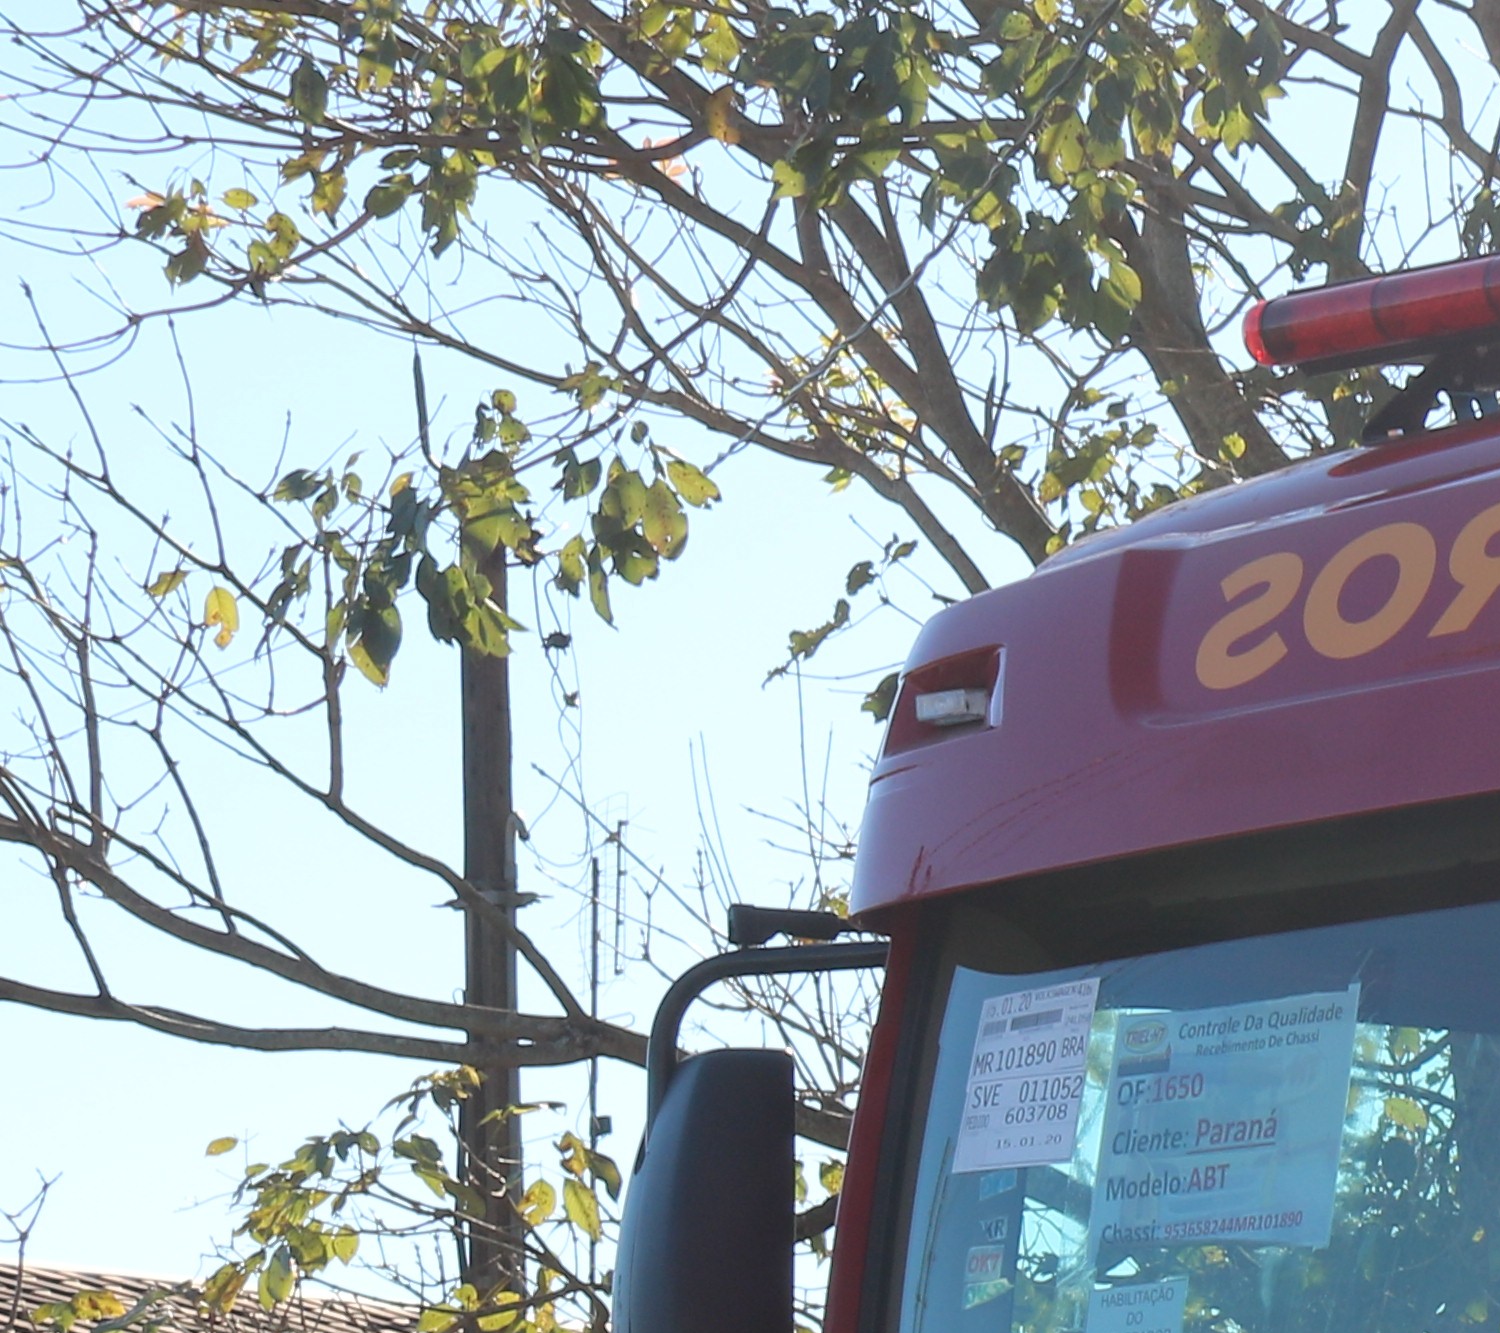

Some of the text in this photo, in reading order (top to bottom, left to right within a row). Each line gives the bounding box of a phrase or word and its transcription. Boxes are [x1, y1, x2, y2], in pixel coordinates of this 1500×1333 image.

[1178, 1003, 1343, 1040] Controle Da Qualidade
[1061, 1036, 1085, 1058] BRA
[1196, 1028, 1320, 1057] Recebimento De Chassi
[971, 1075, 1083, 1109] SVE 011052
[1004, 1103, 1068, 1125] 603708
[996, 1134, 1062, 1149] 15.01.20
[1112, 1108, 1278, 1156] Cliente: Paraná
[1101, 1219, 1160, 1244] Chassi:
[1101, 1286, 1174, 1308] HABILITAÇÃO
[1126, 1312, 1143, 1326] DO
